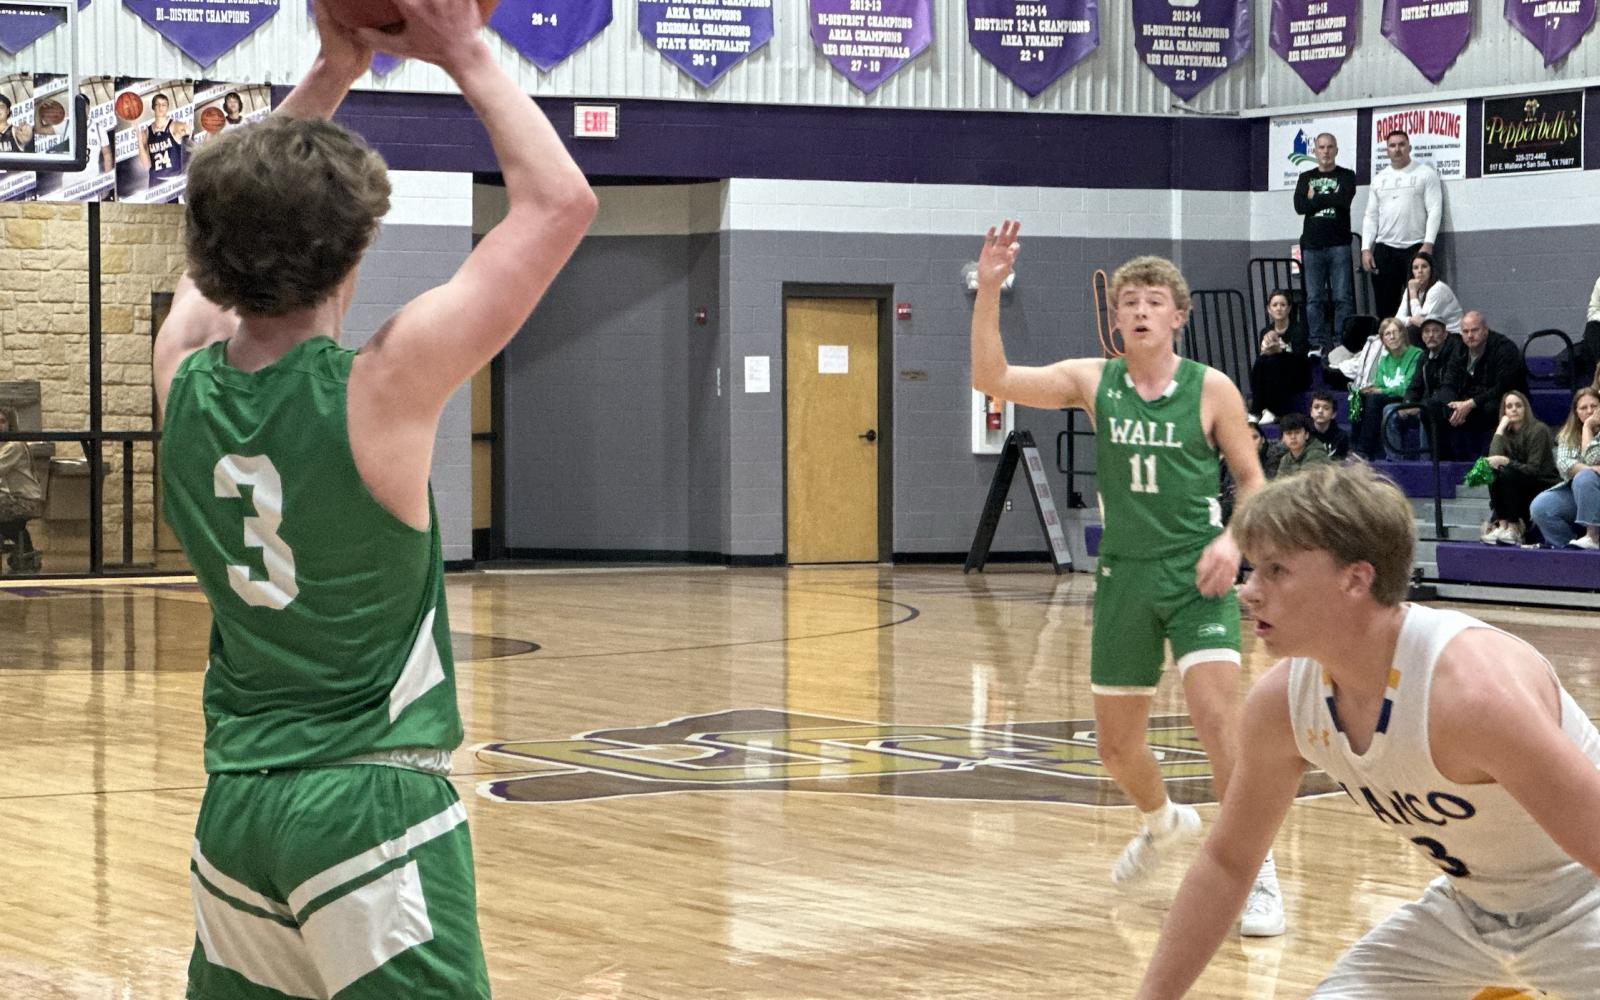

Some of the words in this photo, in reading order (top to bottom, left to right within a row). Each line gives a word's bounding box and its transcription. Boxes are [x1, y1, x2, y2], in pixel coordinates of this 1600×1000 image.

[206, 9, 250, 24] CHAMPIONS
[665, 7, 691, 19] AREA
[693, 8, 742, 22] CHAMPIONS
[1015, 5, 1047, 17] 2013-14
[1172, 10, 1201, 22] 2013-14
[1401, 5, 1430, 21] DISTRICT
[1431, 0, 1469, 17] CHAMPIONS
[818, 13, 866, 27] BI-DISTRICT
[867, 15, 913, 29] CHAMPIONS
[974, 18, 1014, 32] DISTRICT
[1038, 20, 1091, 33] CHAMPIONS
[1290, 20, 1315, 33] DISTRICT
[1315, 16, 1347, 30] CHAMPIONS
[656, 21, 701, 35] REGIONAL
[702, 23, 751, 38] CHAMPIONS
[828, 28, 853, 41] AREA
[855, 29, 902, 43] CHAMPIONS
[1142, 24, 1186, 37] BI-DISTRICT
[1187, 26, 1230, 39] CHAMPIONS
[656, 37, 686, 50] STATE
[688, 38, 751, 52] SEMI-FINALIST
[1001, 34, 1023, 46] AREA
[1025, 35, 1064, 47] FINALIST
[1152, 39, 1175, 51] AREA
[1176, 40, 1220, 53] CHAMPIONS
[1293, 34, 1310, 47] AREA
[1311, 31, 1343, 45] CHAMPIONS
[822, 43, 838, 56] REG
[840, 44, 910, 59] QUARTERFINALS
[1020, 49, 1031, 61] 22
[1301, 45, 1347, 61] QUARTERFINALS
[851, 60, 862, 72] 27
[1146, 53, 1161, 65] REG
[1163, 54, 1228, 68] QUARTERFINALS
[1175, 69, 1186, 81] 22
[584, 111, 609, 132] EXIT
[1376, 110, 1426, 143] ROBERTSON
[1428, 110, 1461, 139] DOZING
[1485, 110, 1579, 149] Pepperbelly's
[153, 151, 173, 171] 24
[1526, 160, 1537, 168] San
[1108, 417, 1183, 448] WALL
[1129, 453, 1159, 493] 11
[214, 454, 299, 611] 3
[1411, 836, 1471, 878] 3
